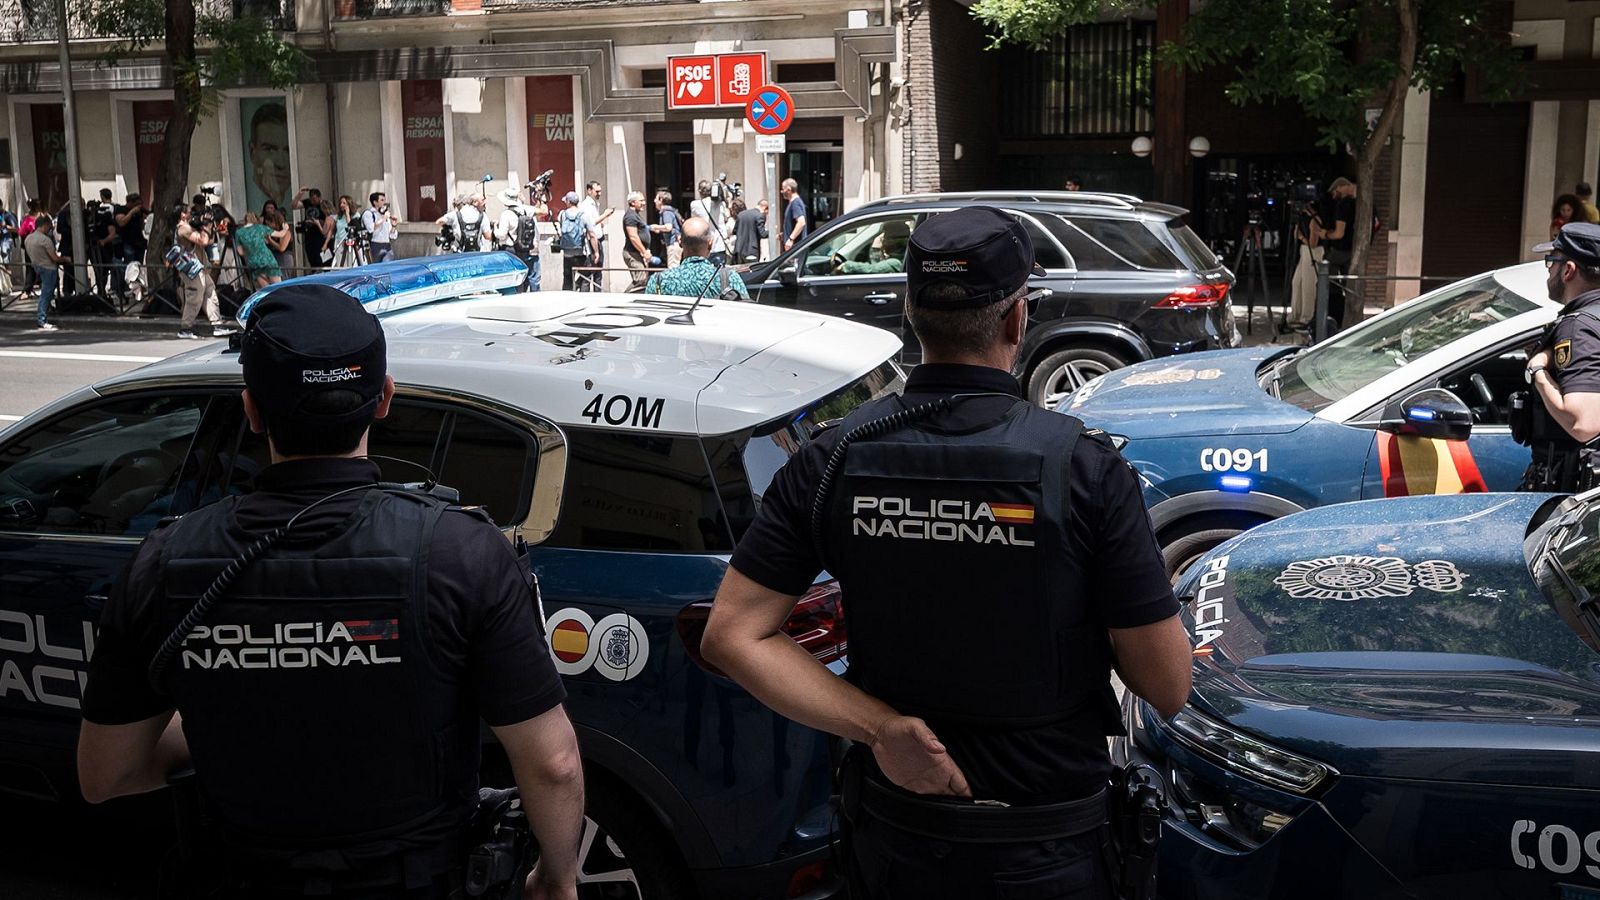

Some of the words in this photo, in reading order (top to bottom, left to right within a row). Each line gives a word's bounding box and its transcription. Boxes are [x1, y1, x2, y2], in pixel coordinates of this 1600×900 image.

[675, 65, 711, 81] PSOE
[303, 373, 361, 382] NACIONAL
[853, 518, 1035, 546] NACIONAL
[182, 645, 400, 669] NACIONAL
